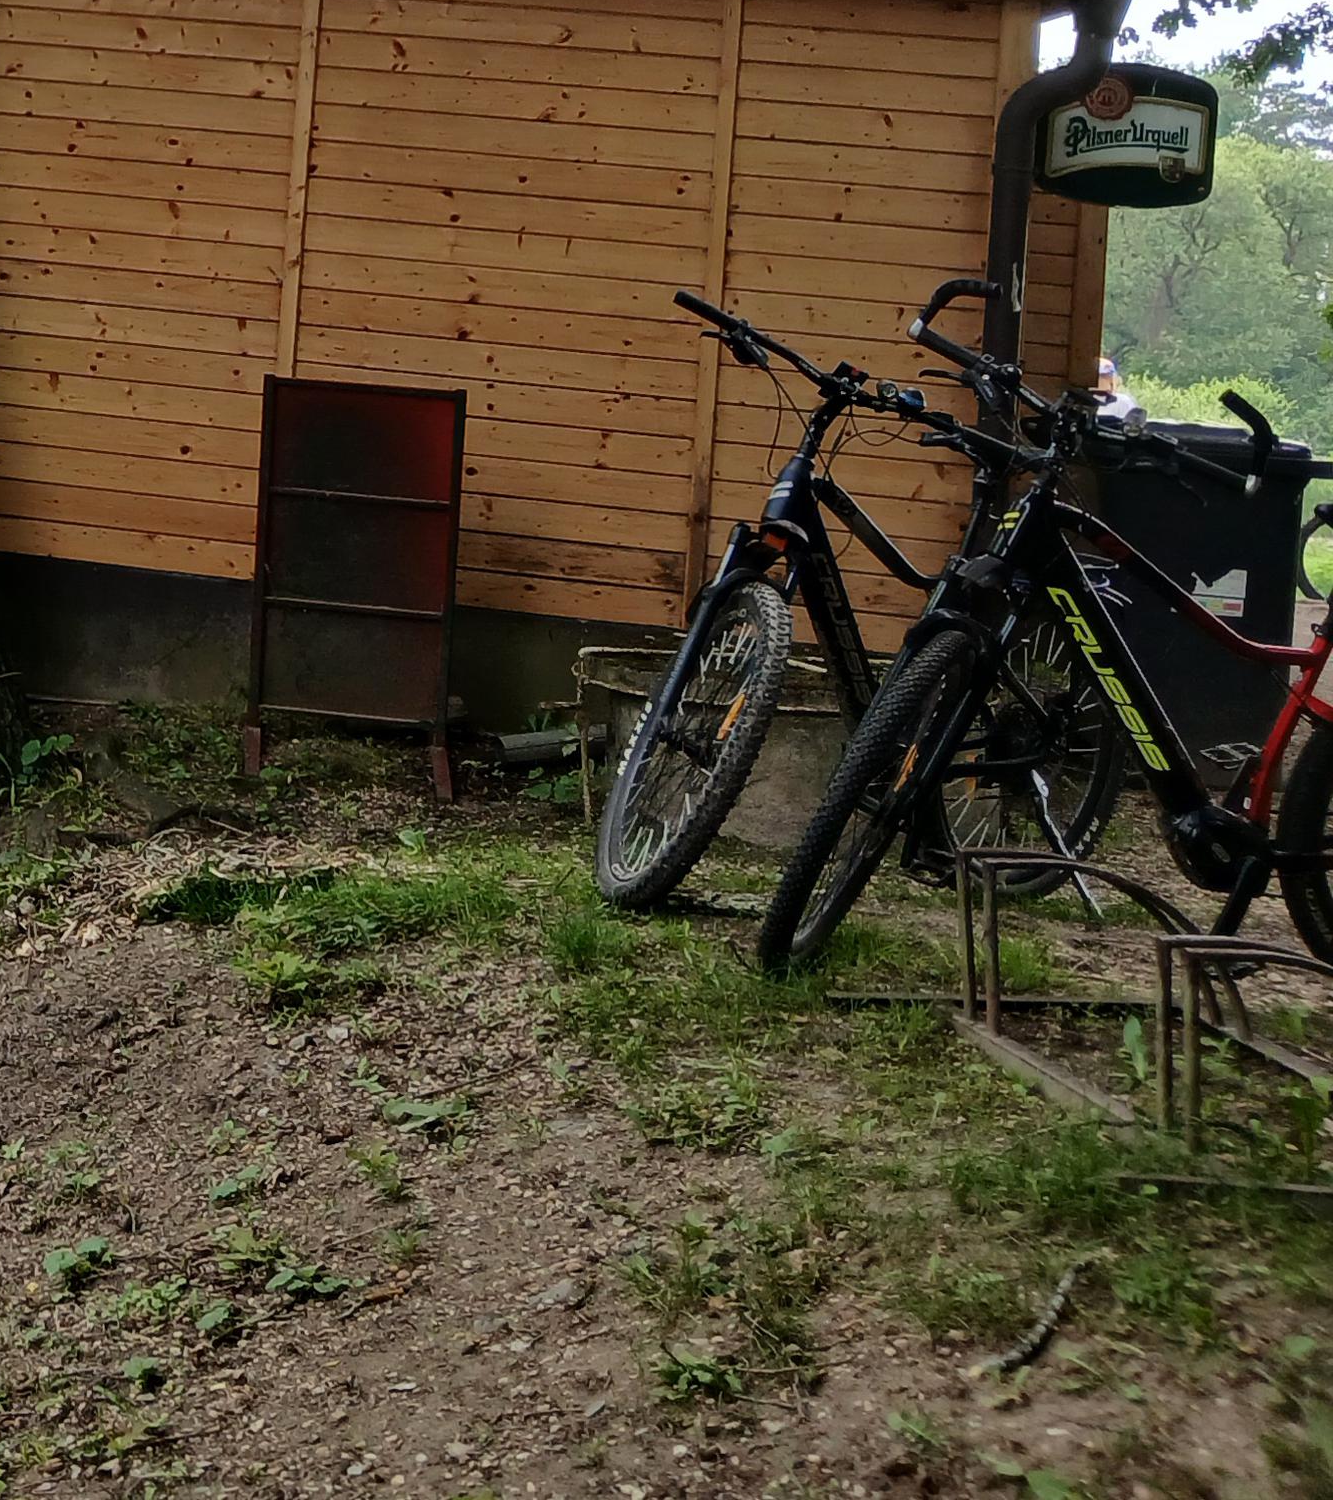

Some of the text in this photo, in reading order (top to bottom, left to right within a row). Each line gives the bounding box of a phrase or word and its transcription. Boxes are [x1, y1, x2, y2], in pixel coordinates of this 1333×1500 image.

[1064, 116, 1189, 158] Pilsner Urquell
[1046, 586, 1171, 771] CRUSSIS
